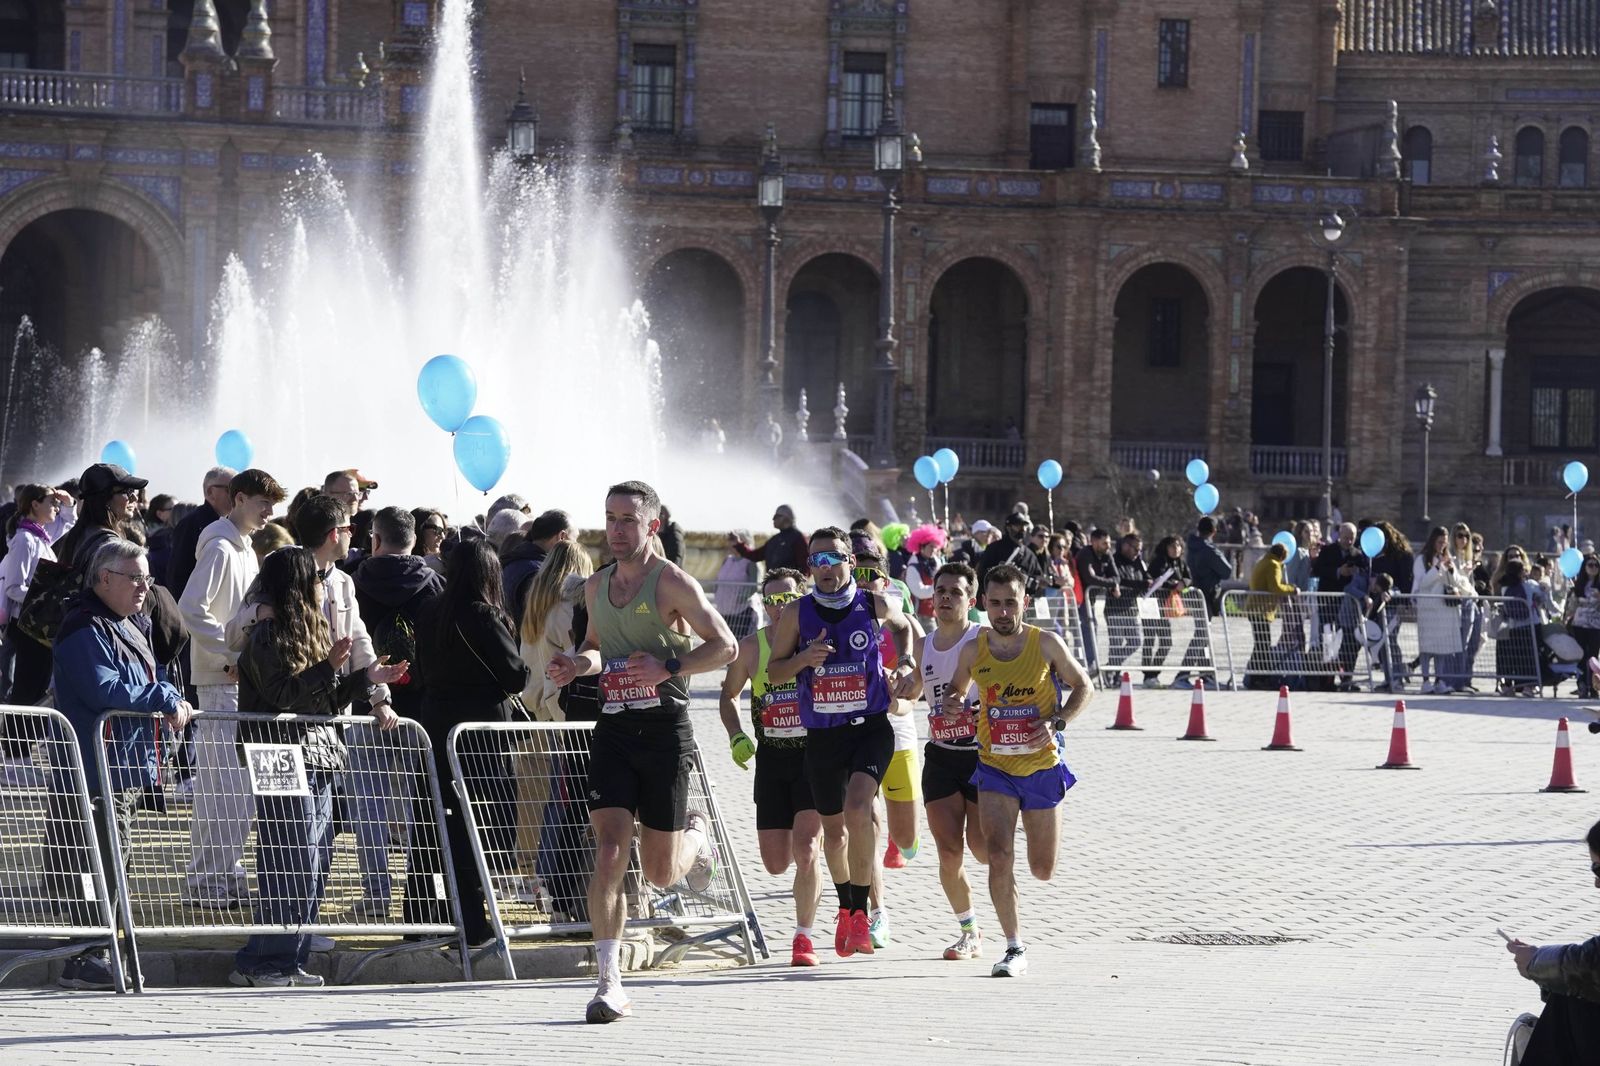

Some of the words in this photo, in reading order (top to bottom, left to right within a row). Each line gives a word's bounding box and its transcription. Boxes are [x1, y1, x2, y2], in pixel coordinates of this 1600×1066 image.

[828, 665, 858, 674] ZURICH
[618, 676, 633, 686] 915
[830, 680, 846, 689] 1141
[607, 688, 620, 701] JOE
[621, 685, 657, 700] KENNY
[813, 691, 825, 702] JA
[826, 689, 866, 701] MARCOS
[1002, 683, 1036, 698] Álora
[776, 692, 799, 701] ZURIC
[778, 706, 794, 714] 1075
[1003, 708, 1033, 717] ZURICH
[772, 715, 802, 727] DAVID
[934, 725, 970, 740] BASTIEN
[1006, 723, 1019, 731] 672
[1000, 732, 1029, 744] JESUS
[260, 751, 290, 772] AMS
